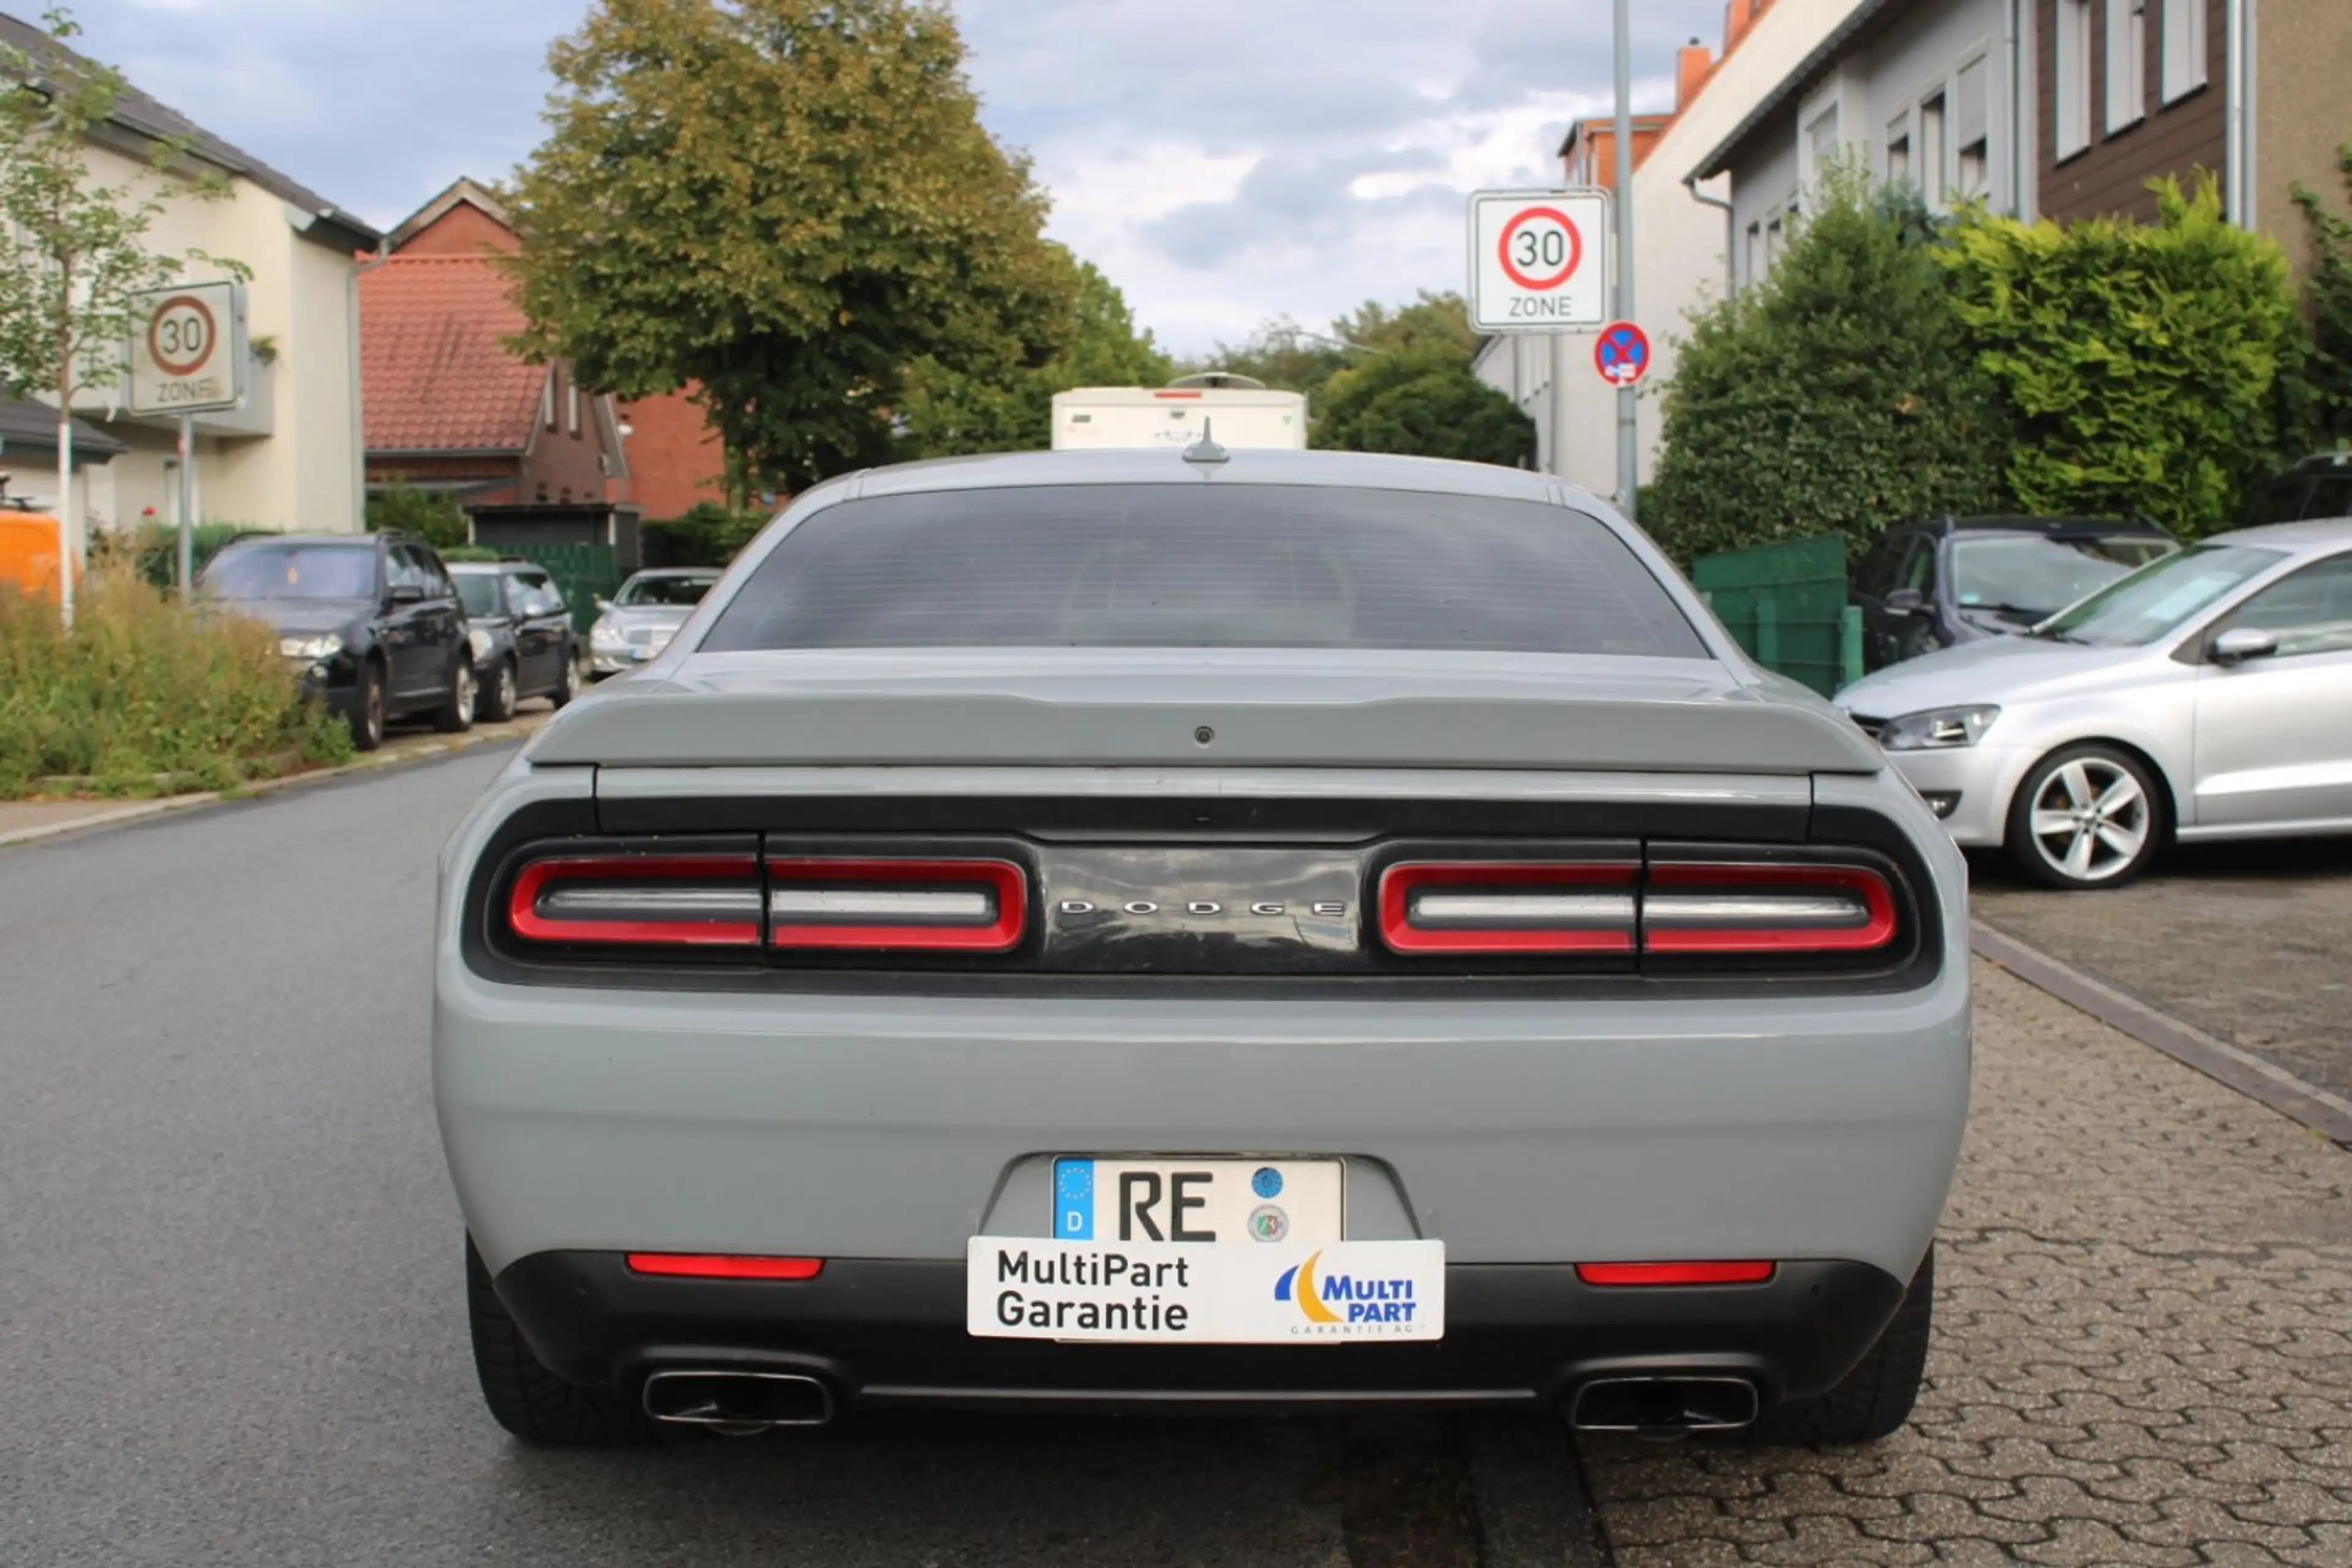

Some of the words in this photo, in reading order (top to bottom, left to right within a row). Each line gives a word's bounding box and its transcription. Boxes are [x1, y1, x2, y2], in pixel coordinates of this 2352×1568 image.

[1515, 230, 1563, 266] 30
[1509, 296, 1572, 317] ZONE
[161, 317, 200, 354] 30
[1060, 900, 1344, 916] DODGE
[1067, 1210, 1083, 1232] D
[1118, 1171, 1216, 1242] RE
[998, 1250, 1188, 1287] MultiPart
[1322, 1275, 1413, 1300] MULTI
[997, 1289, 1188, 1331] Garantie
[1348, 1302, 1417, 1322] PART
[1393, 1324, 1412, 1333] AG
